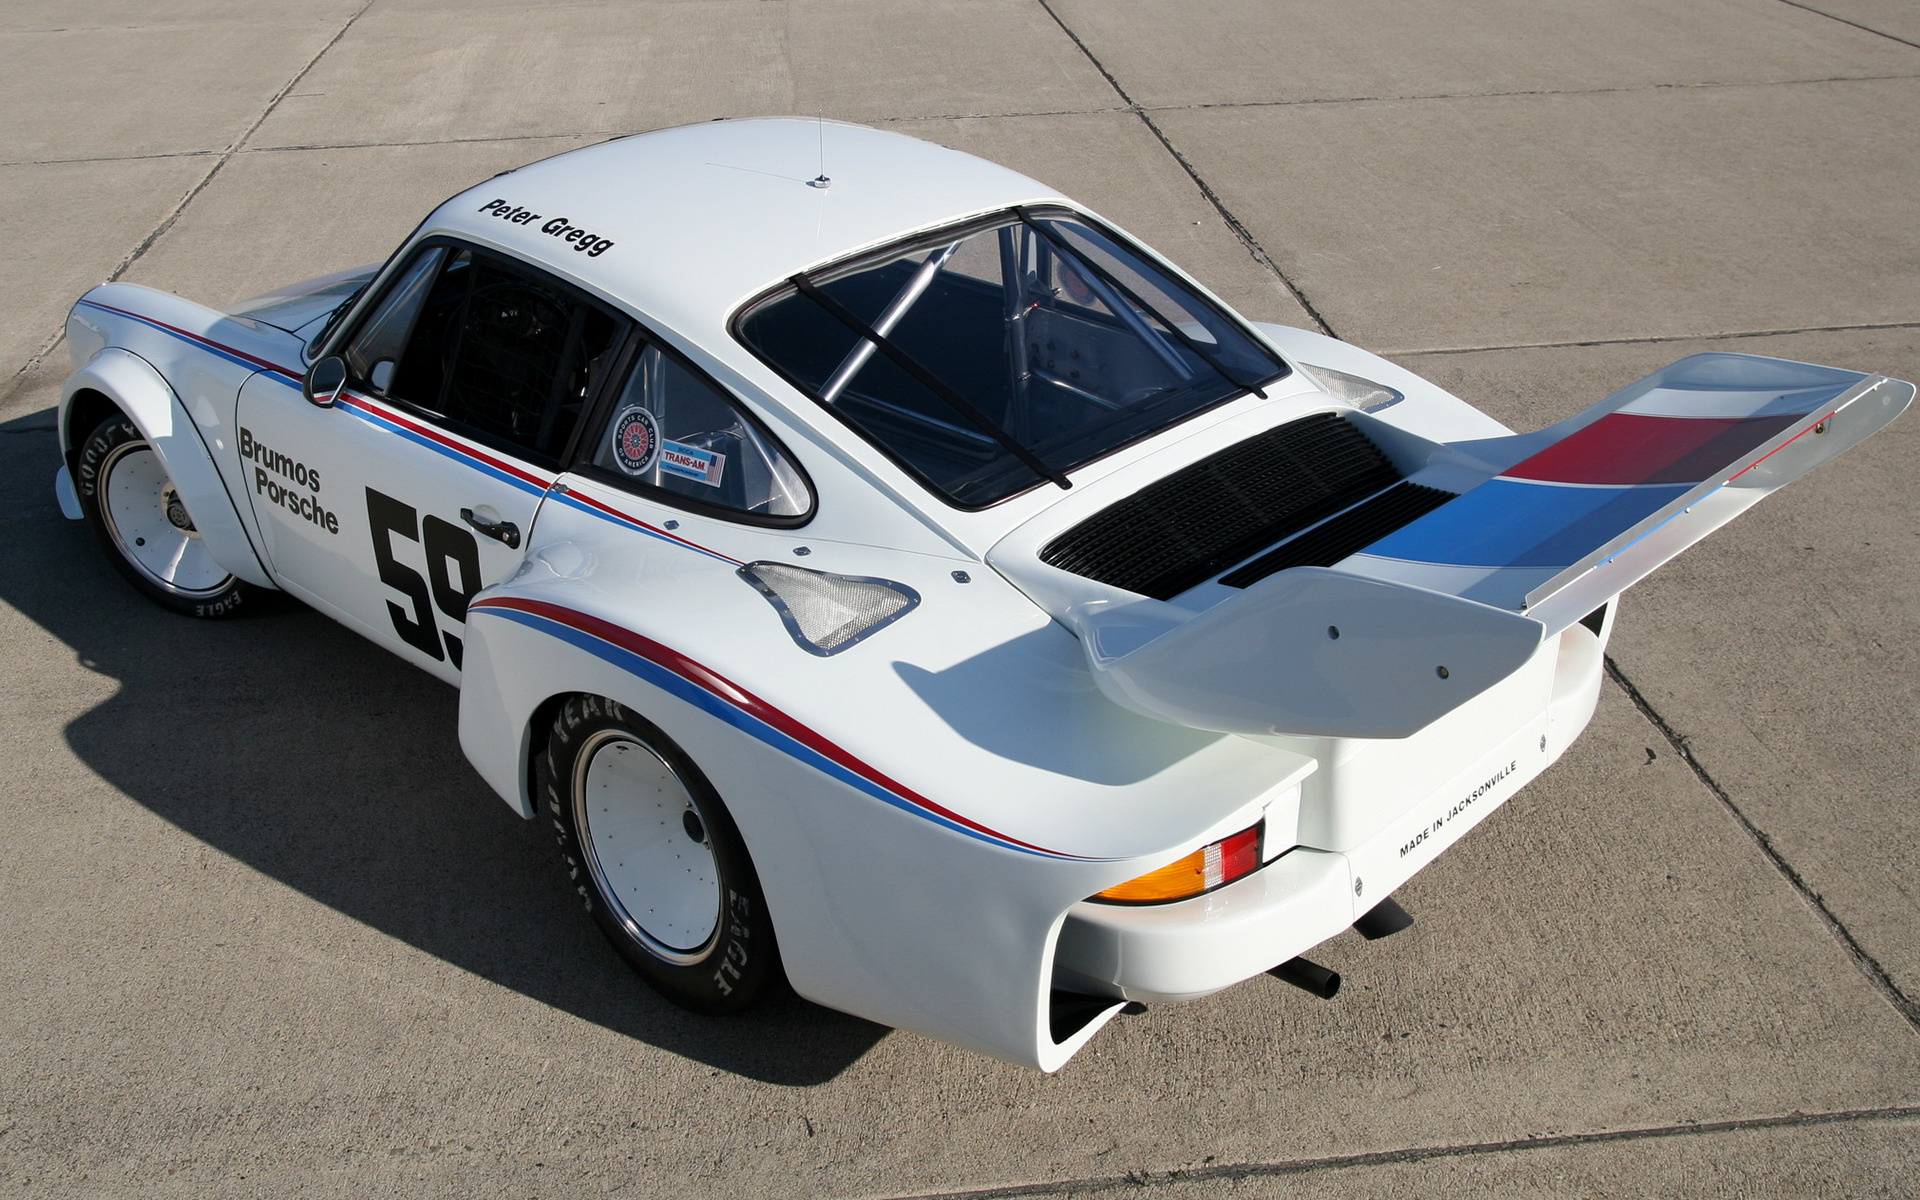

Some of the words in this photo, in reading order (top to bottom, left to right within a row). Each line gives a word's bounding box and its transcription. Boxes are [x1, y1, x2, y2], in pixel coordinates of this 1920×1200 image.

[478, 199, 542, 226] Peter
[541, 217, 615, 258] Gregg
[618, 415, 636, 439] SPORTS
[637, 415, 649, 426] CAR
[678, 447, 694, 456] SCCA
[240, 426, 321, 493] Brumos
[618, 448, 625, 457] OF
[624, 455, 649, 468] AMERICA
[665, 451, 705, 471] TRANS-AM
[255, 466, 339, 535] Porsche
[195, 590, 243, 617] EAGLE
[365, 486, 483, 672] 59
[1400, 827, 1430, 858] MADE
[1433, 817, 1443, 833] IN
[1446, 760, 1517, 822] JACKSONVILLE
[713, 889, 750, 997] EAGLE
